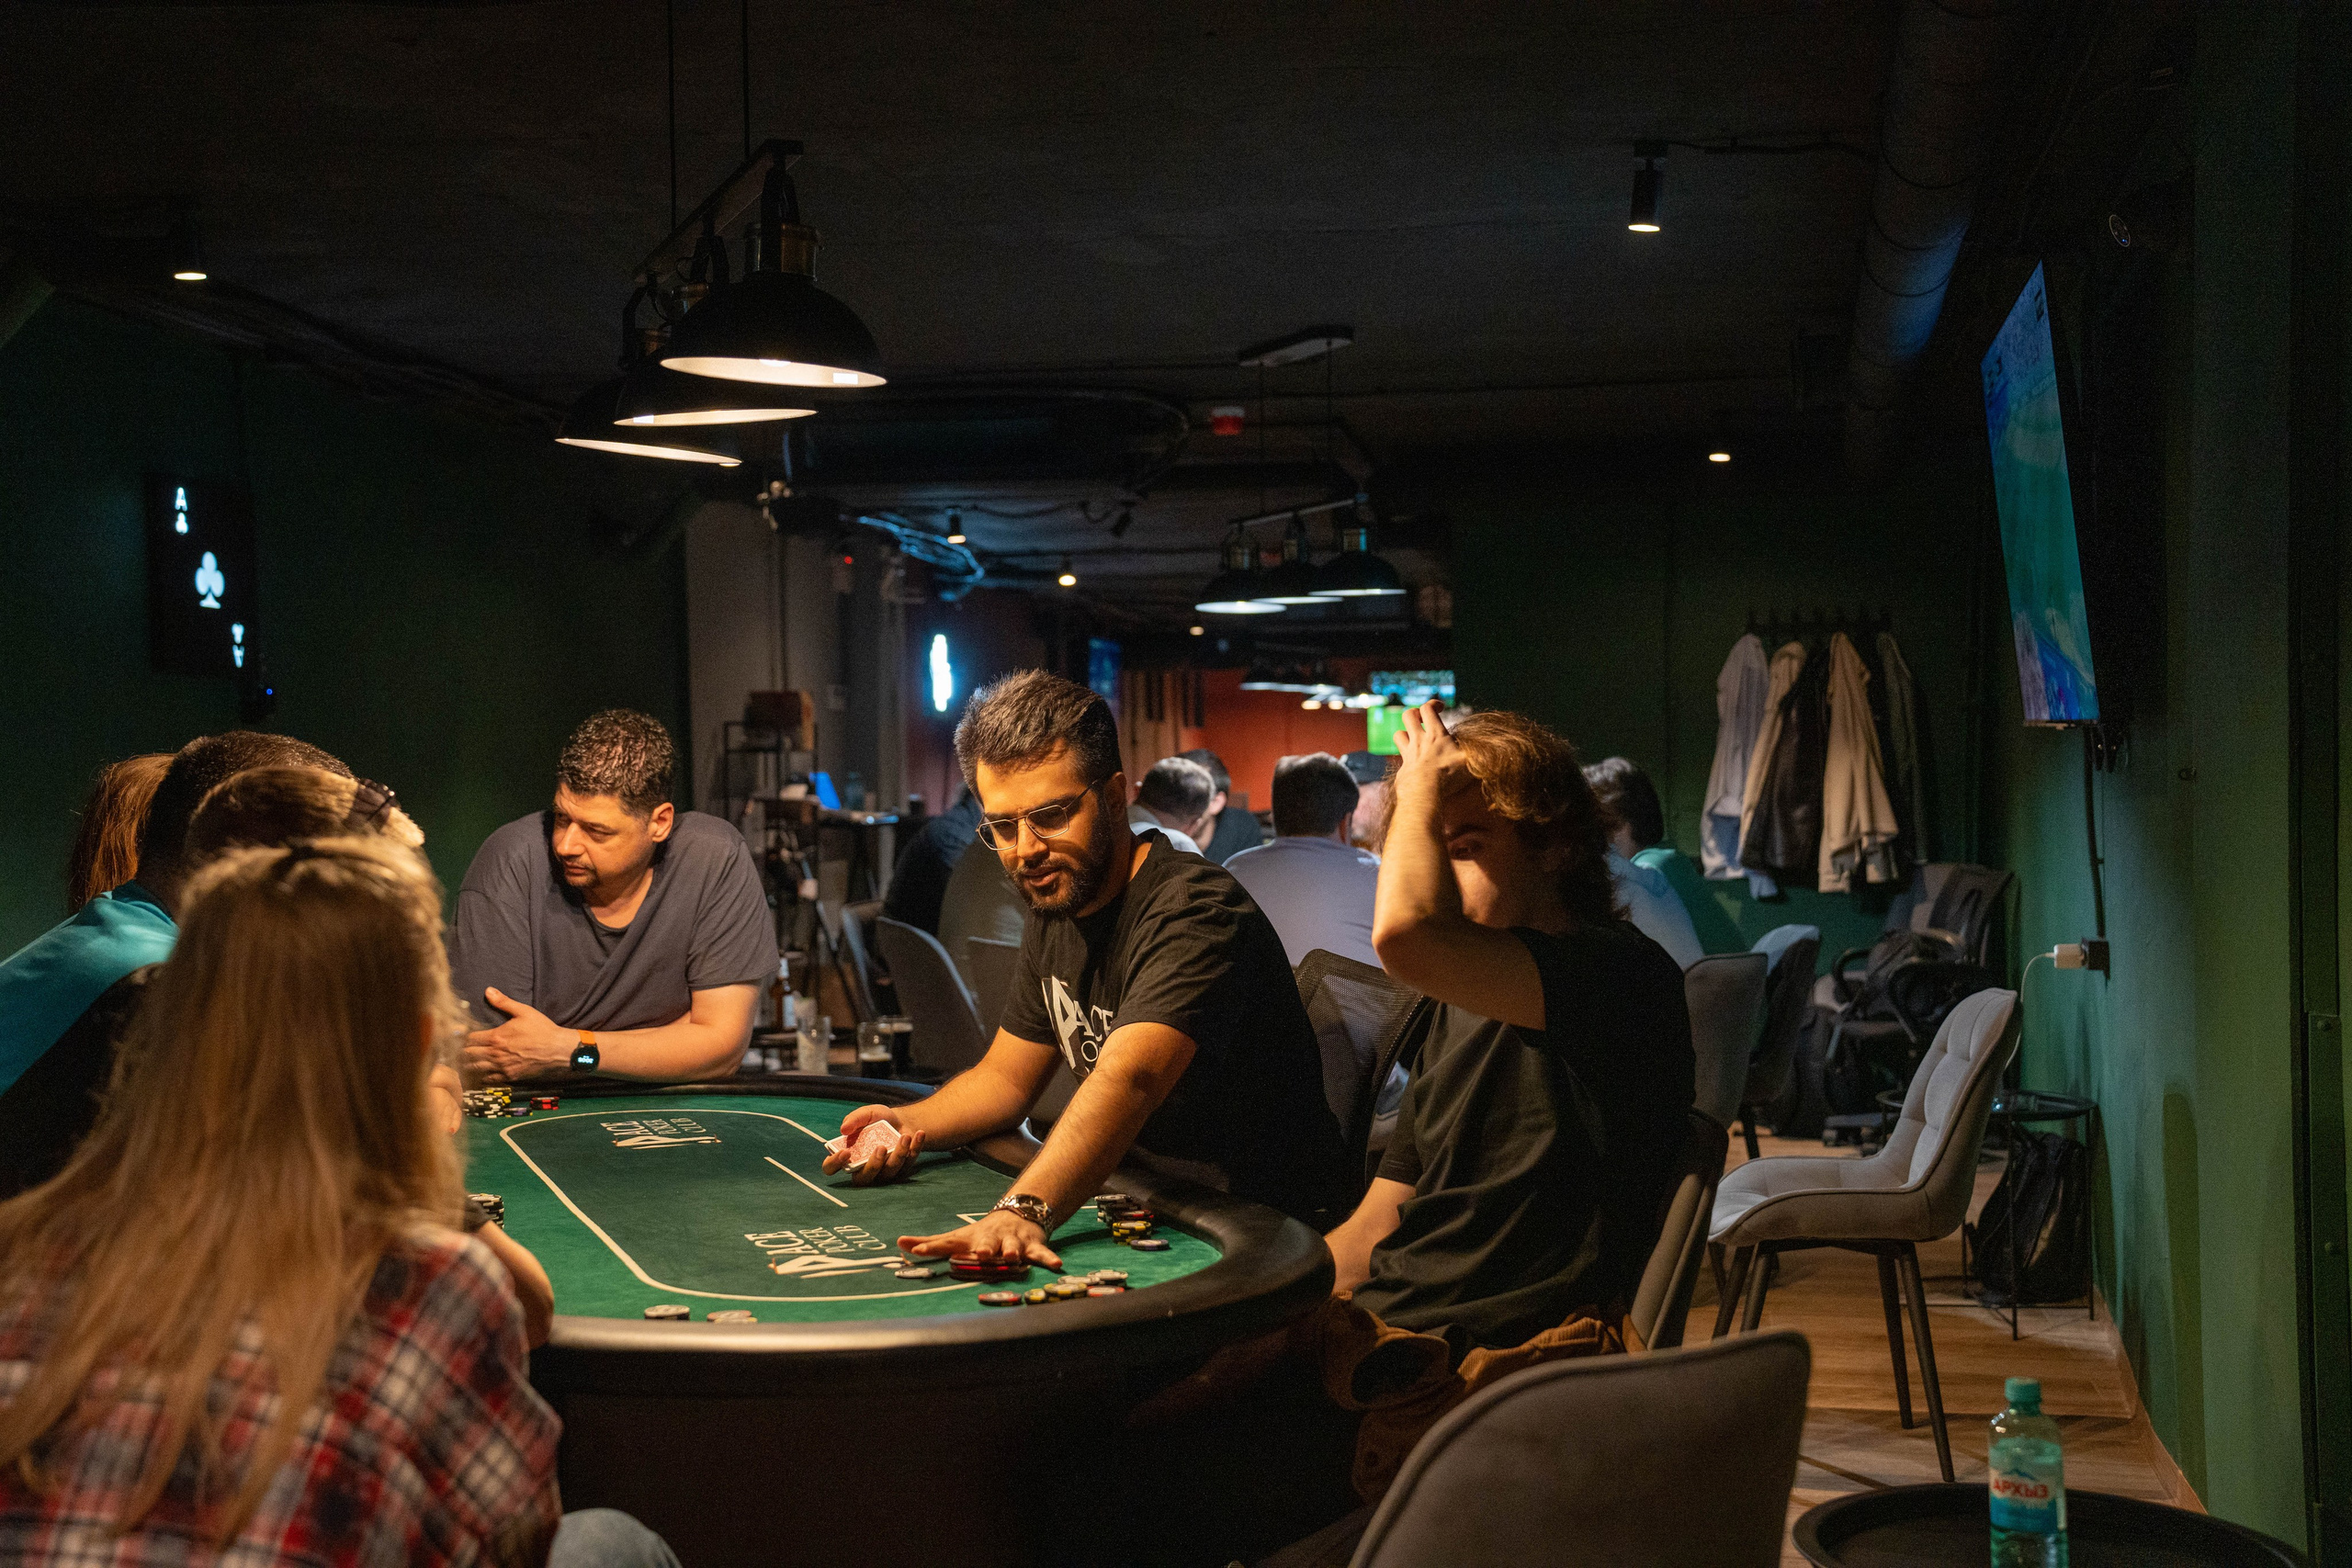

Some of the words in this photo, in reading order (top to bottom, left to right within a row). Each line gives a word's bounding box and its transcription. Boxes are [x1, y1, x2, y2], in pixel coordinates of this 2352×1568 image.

[175, 488, 187, 511] A
[232, 645, 244, 668] A
[600, 1121, 653, 1135] ACE
[642, 1119, 681, 1134] POKER
[670, 1118, 707, 1133] CLUB
[744, 1231, 820, 1255] ACE
[798, 1226, 855, 1253] POKER
[833, 1224, 887, 1250] CLUB
[1994, 1479, 2048, 1499] АРХЫЗ
